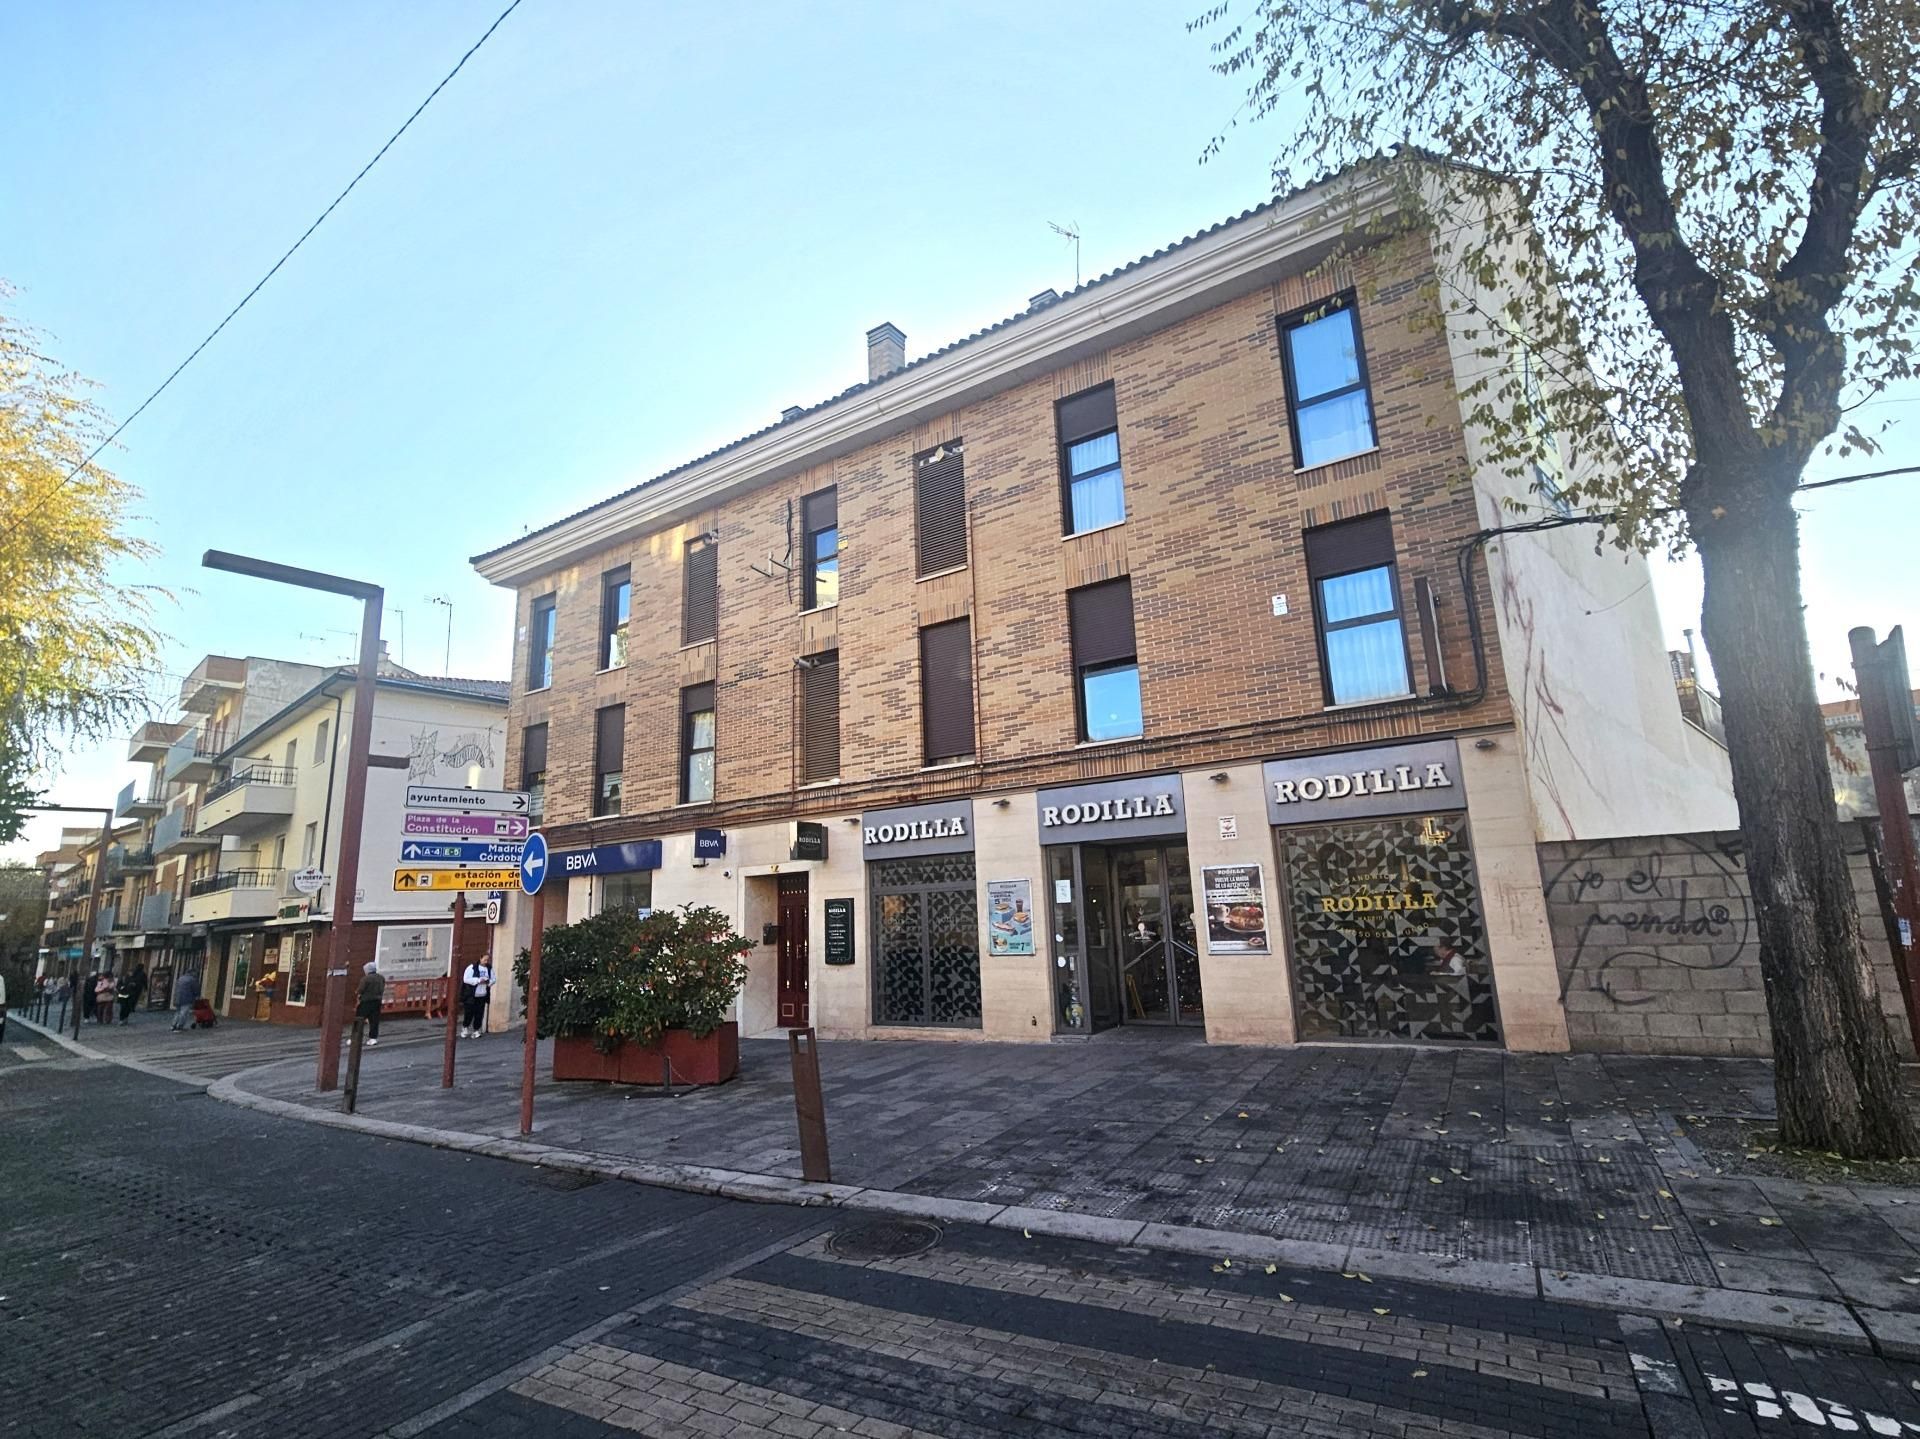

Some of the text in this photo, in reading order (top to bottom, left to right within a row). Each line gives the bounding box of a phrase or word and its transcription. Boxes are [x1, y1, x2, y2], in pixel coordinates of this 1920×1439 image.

[1273, 762, 1452, 804] RODILLA
[410, 794, 486, 806] ayuntamiento
[1042, 793, 1175, 828] RODILLA
[407, 815, 460, 824] Plaza de la
[407, 823, 478, 835] Constitución
[864, 816, 967, 845] RODILLA
[699, 839, 719, 848] BBVA
[566, 851, 598, 871] BBVA
[454, 870, 521, 879] estación de
[1573, 852, 1664, 903] yo el
[465, 880, 520, 888] ferrocarril
[1321, 893, 1438, 913] RODILLA
